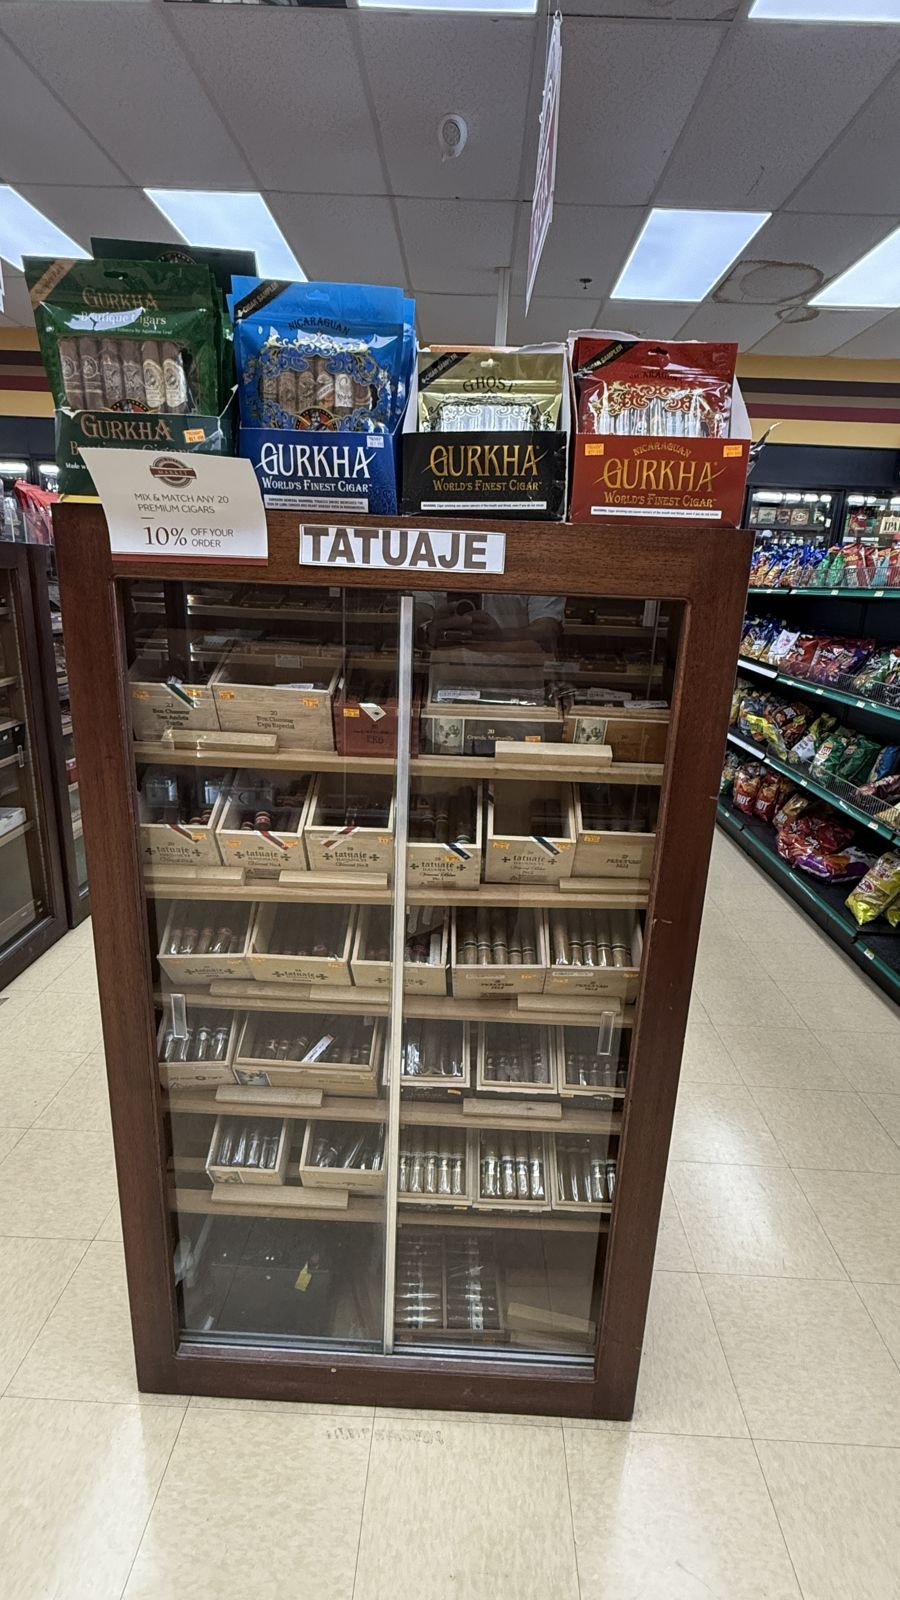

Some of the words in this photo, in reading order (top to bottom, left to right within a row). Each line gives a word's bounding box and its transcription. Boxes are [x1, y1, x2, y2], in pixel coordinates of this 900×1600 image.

[82, 287, 160, 311] GURKHA
[288, 317, 350, 336] NICARAGUAN
[462, 376, 514, 393] GHOST
[80, 413, 175, 442] GURKHA
[633, 441, 691, 457] NICARAGUAN
[256, 442, 376, 479] GURKHA
[422, 445, 549, 477] GURKHA
[593, 458, 727, 492] GURKHA
[303, 479, 336, 491] FINEST
[475, 479, 507, 491] FINEST
[134, 493, 150, 501] MIX
[161, 494, 196, 503] MATCH
[217, 495, 229, 503] 20
[647, 493, 681, 506] FINEST
[138, 504, 180, 513] PREMIUM
[182, 505, 215, 514] CIGARS
[884, 521, 897, 531] IPA
[144, 526, 187, 546] 10%
[191, 528, 208, 536] OFF
[209, 528, 234, 537] YOUR
[192, 539, 221, 547] ORDER
[303, 526, 488, 570] TATUAJE
[246, 850, 278, 858] tatuaje
[335, 851, 367, 859] tatuaje
[513, 855, 545, 863] tatuaje
[421, 862, 454, 870] tatuaje
